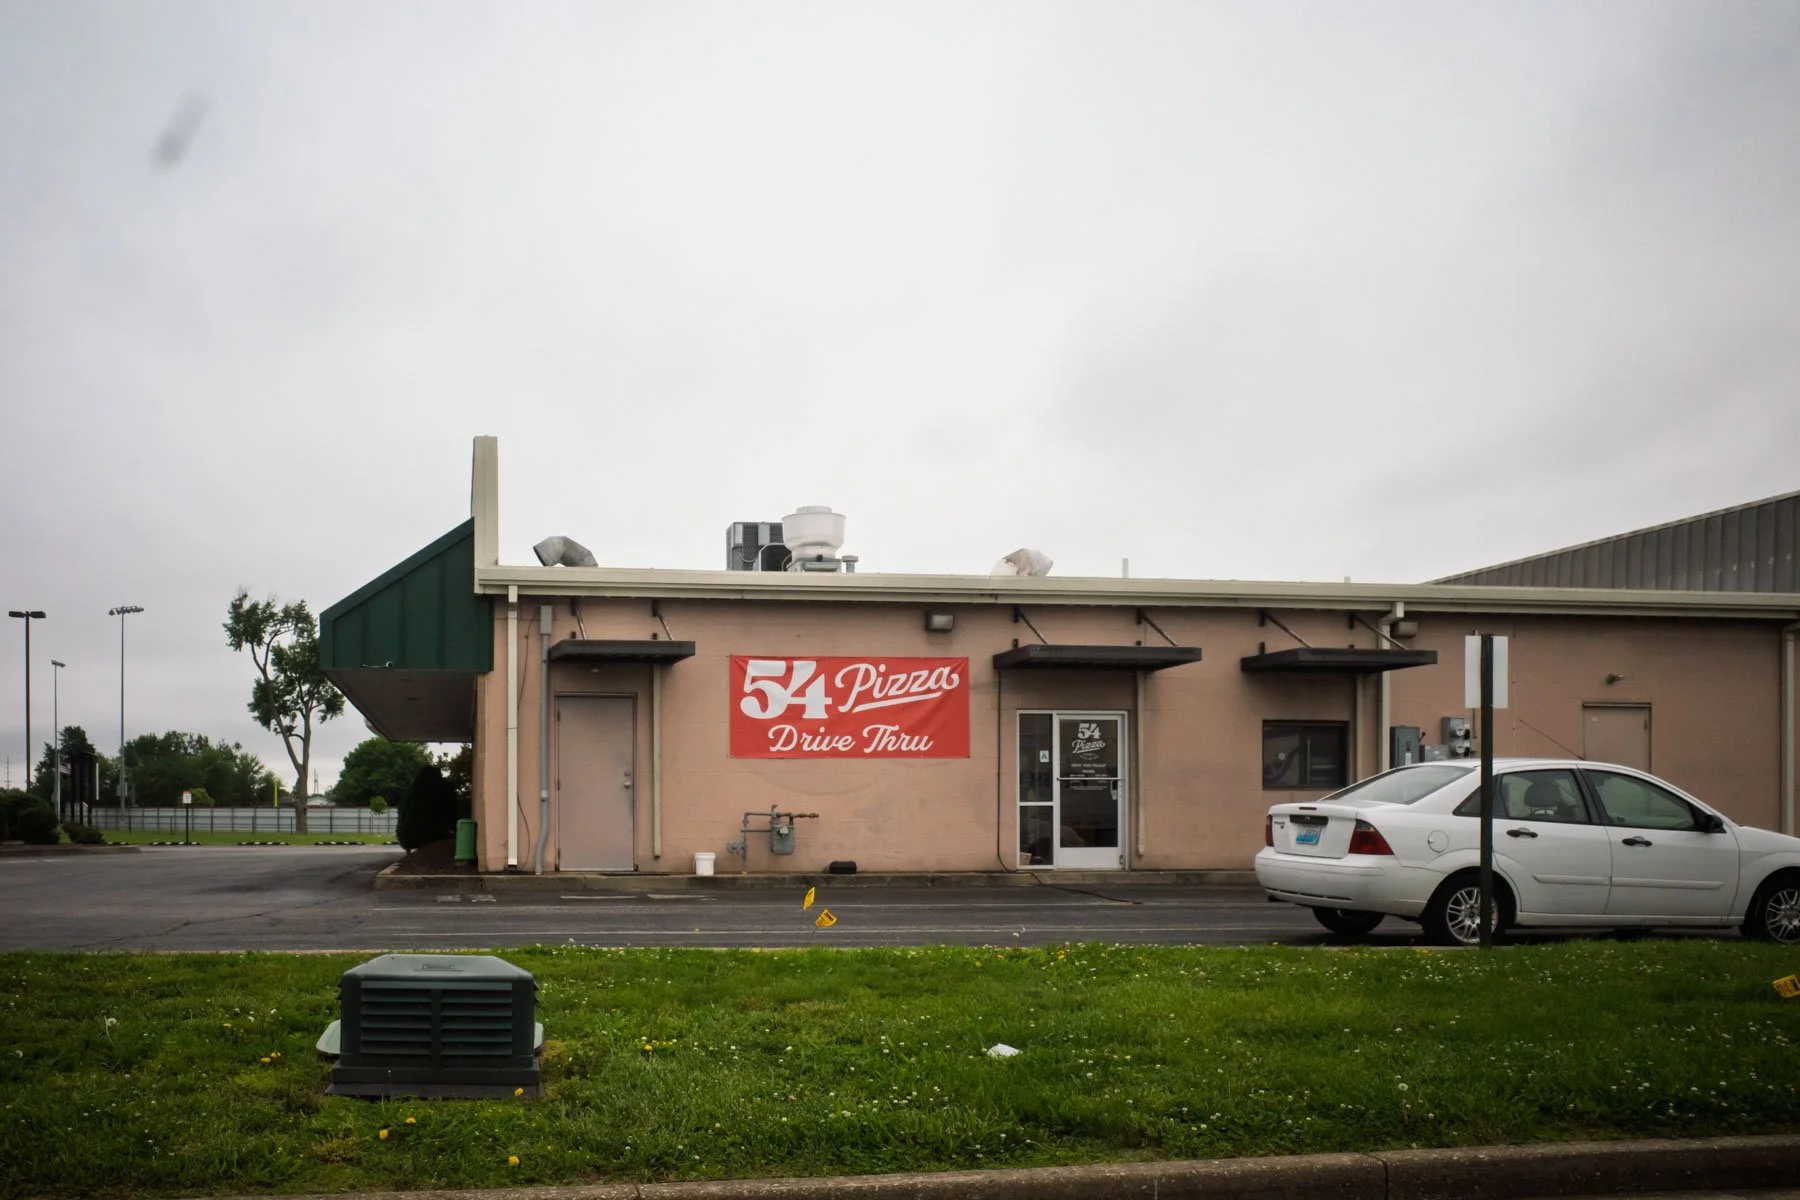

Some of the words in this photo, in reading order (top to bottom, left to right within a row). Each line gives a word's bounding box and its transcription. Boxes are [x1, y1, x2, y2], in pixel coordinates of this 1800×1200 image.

[740, 660, 832, 719] 54
[835, 663, 960, 713] Pizza
[768, 724, 855, 752] Drive
[863, 724, 933, 753] Thru
[1078, 723, 1101, 739] 54
[1072, 740, 1105, 754] Pizza
